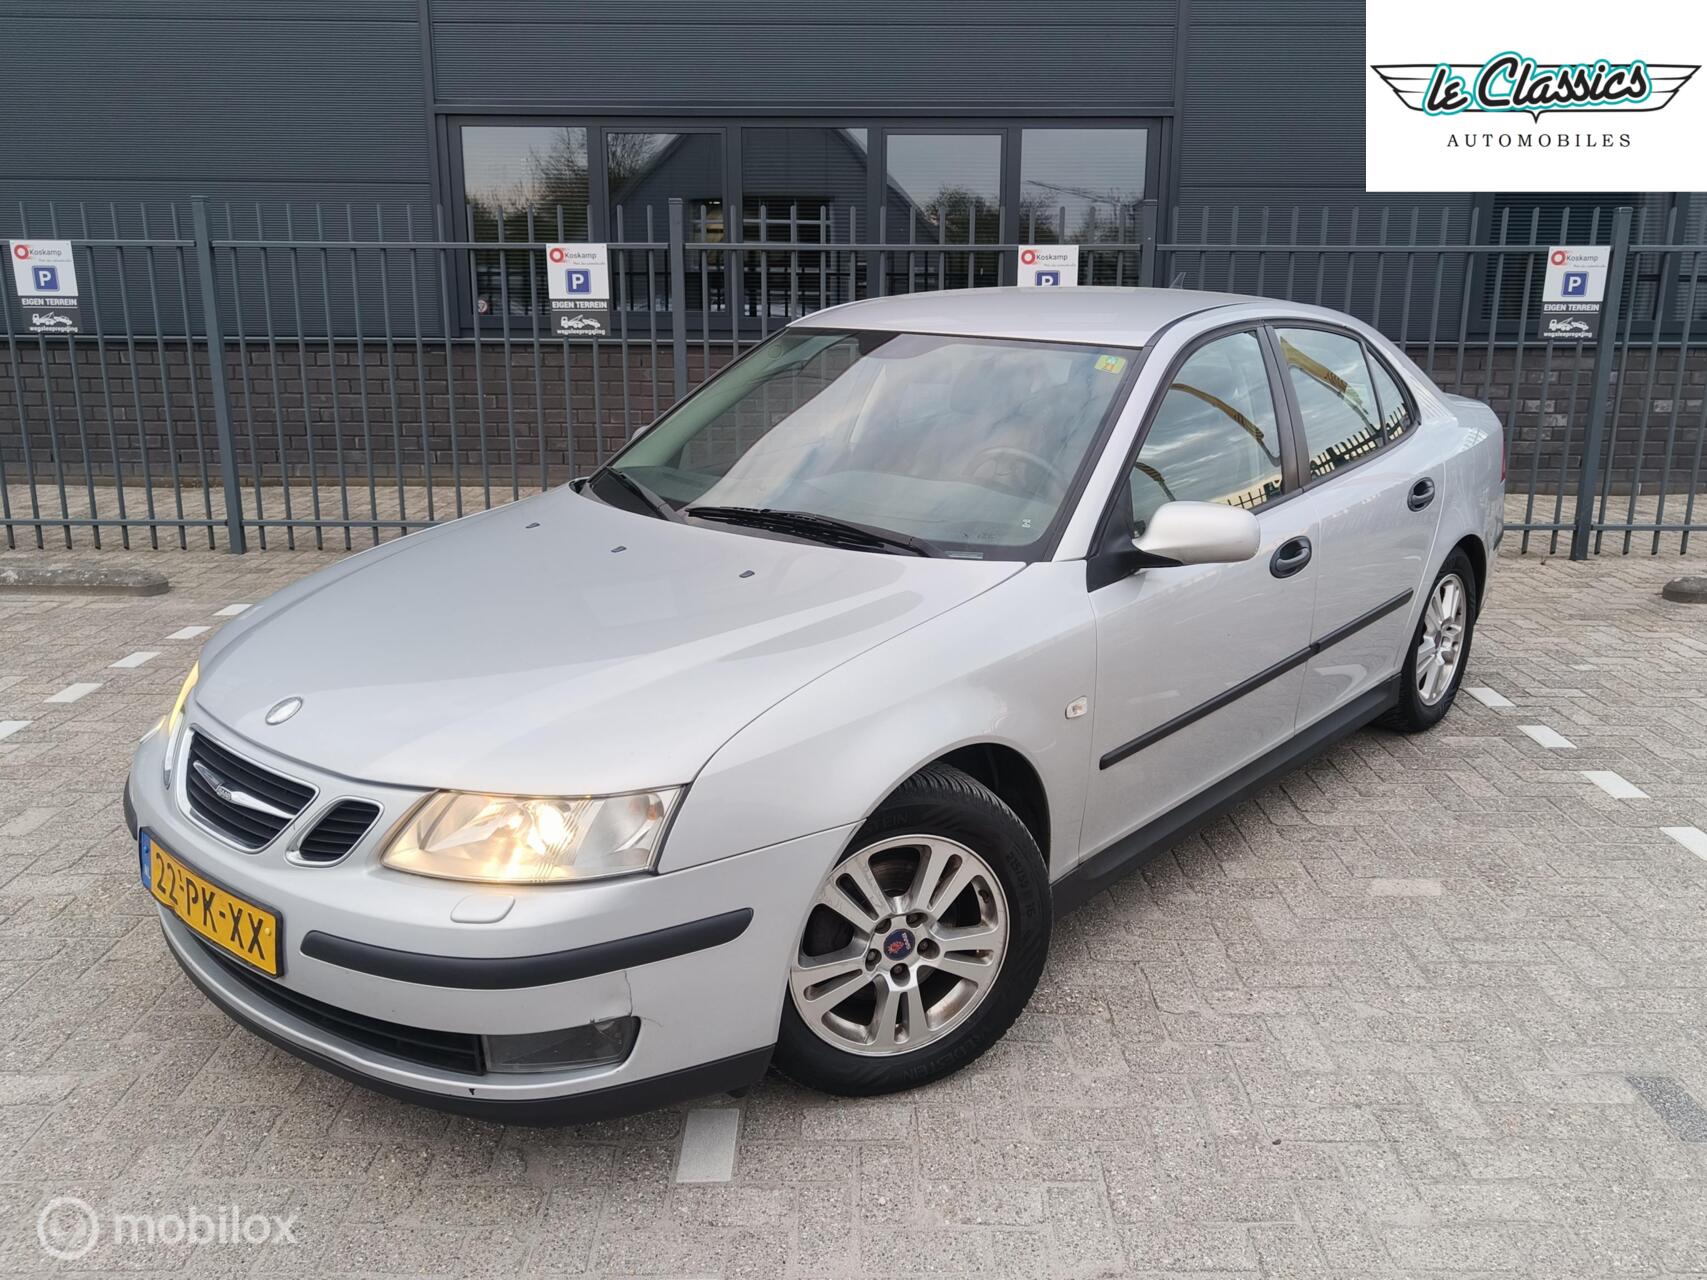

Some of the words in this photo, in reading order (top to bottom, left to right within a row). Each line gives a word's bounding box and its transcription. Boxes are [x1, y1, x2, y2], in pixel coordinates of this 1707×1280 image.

[29, 248, 62, 257] Koskamp
[564, 252, 597, 260] Koskamp
[1036, 253, 1068, 261] Koskamp
[1566, 254, 1599, 263] Koskamp
[38, 270, 51, 287] P
[571, 273, 584, 290] P
[1568, 276, 1581, 293] P
[21, 298, 44, 306] EIGEN
[45, 298, 77, 306] TERREIN
[552, 301, 574, 309] EIGEN
[576, 301, 608, 309] TERREIN
[1543, 303, 1567, 311] EIGEN
[1568, 303, 1600, 311] TERREIN
[155, 852, 265, 961] 22-PK-XX
